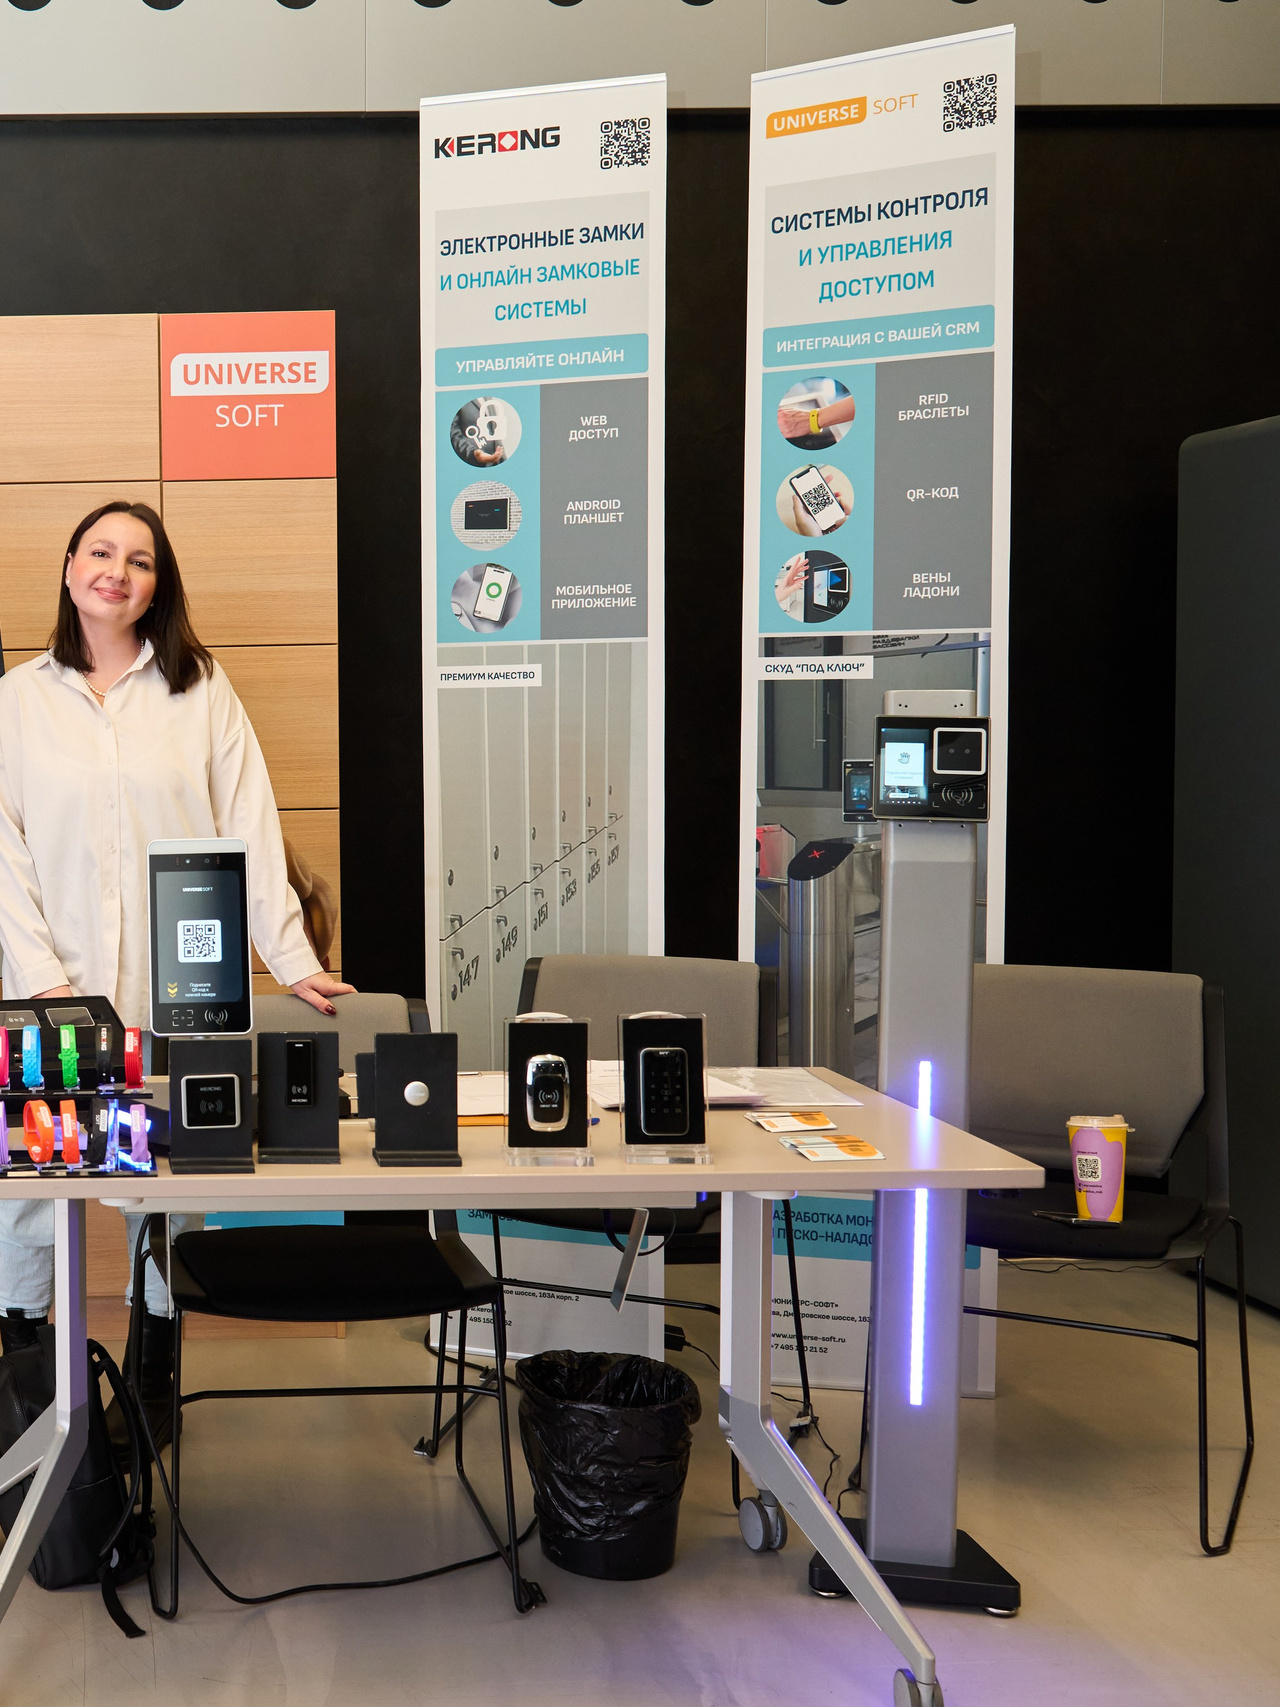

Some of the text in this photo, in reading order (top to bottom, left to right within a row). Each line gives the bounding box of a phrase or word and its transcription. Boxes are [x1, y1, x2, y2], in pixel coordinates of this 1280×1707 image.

[772, 94, 919, 132] UNIVERSE SOFT
[434, 126, 561, 159] KERONG
[771, 187, 989, 234] СИСТЕМЫ КОНТРОЛЯ
[440, 222, 645, 257] ЭЛЕКТРОННЫЕ ЗАМКИ
[799, 230, 953, 267] И УПРАВЛЕНИЯ
[440, 258, 640, 291] И ОНЛАЙН ЗАМКОВЫЕ
[818, 270, 935, 303] ДОСТУПОМ
[495, 298, 587, 322] СИСТЕМЫ
[776, 321, 980, 353] ИНТЕГРАЦИЯ С ВАШЕЙ CRM
[456, 348, 625, 374] УПРАВЛЯЙТЕ ОНЛАЙН
[182, 360, 318, 386] UNIVERSE
[919, 393, 948, 405] RFID
[214, 404, 284, 428] SOFT
[580, 415, 608, 426] WEB
[898, 406, 969, 421] БРАСЛЕТЫ
[569, 428, 619, 442] ДОСТУП
[906, 486, 959, 502] QR-КОД
[566, 499, 621, 511] ANDROID
[564, 512, 624, 525] ПЛАНШЕТ
[912, 572, 951, 584] ВЕНЫ
[556, 584, 632, 596] МОБИЛЬНОЕ
[903, 585, 960, 599] ЛАДОНИ
[551, 597, 637, 610] ПРИЛОЖЕНИЕ
[440, 671, 535, 682] ПРЕМИУМ КАЧЕСТВО
[764, 663, 794, 674] СКУД
[537, 901, 549, 927] 151
[501, 926, 518, 958] 149
[458, 954, 480, 993] 147
[515, 1290, 538, 1299] шоссе,
[556, 1294, 574, 1302] корп.
[831, 1315, 857, 1323] шоссе,
